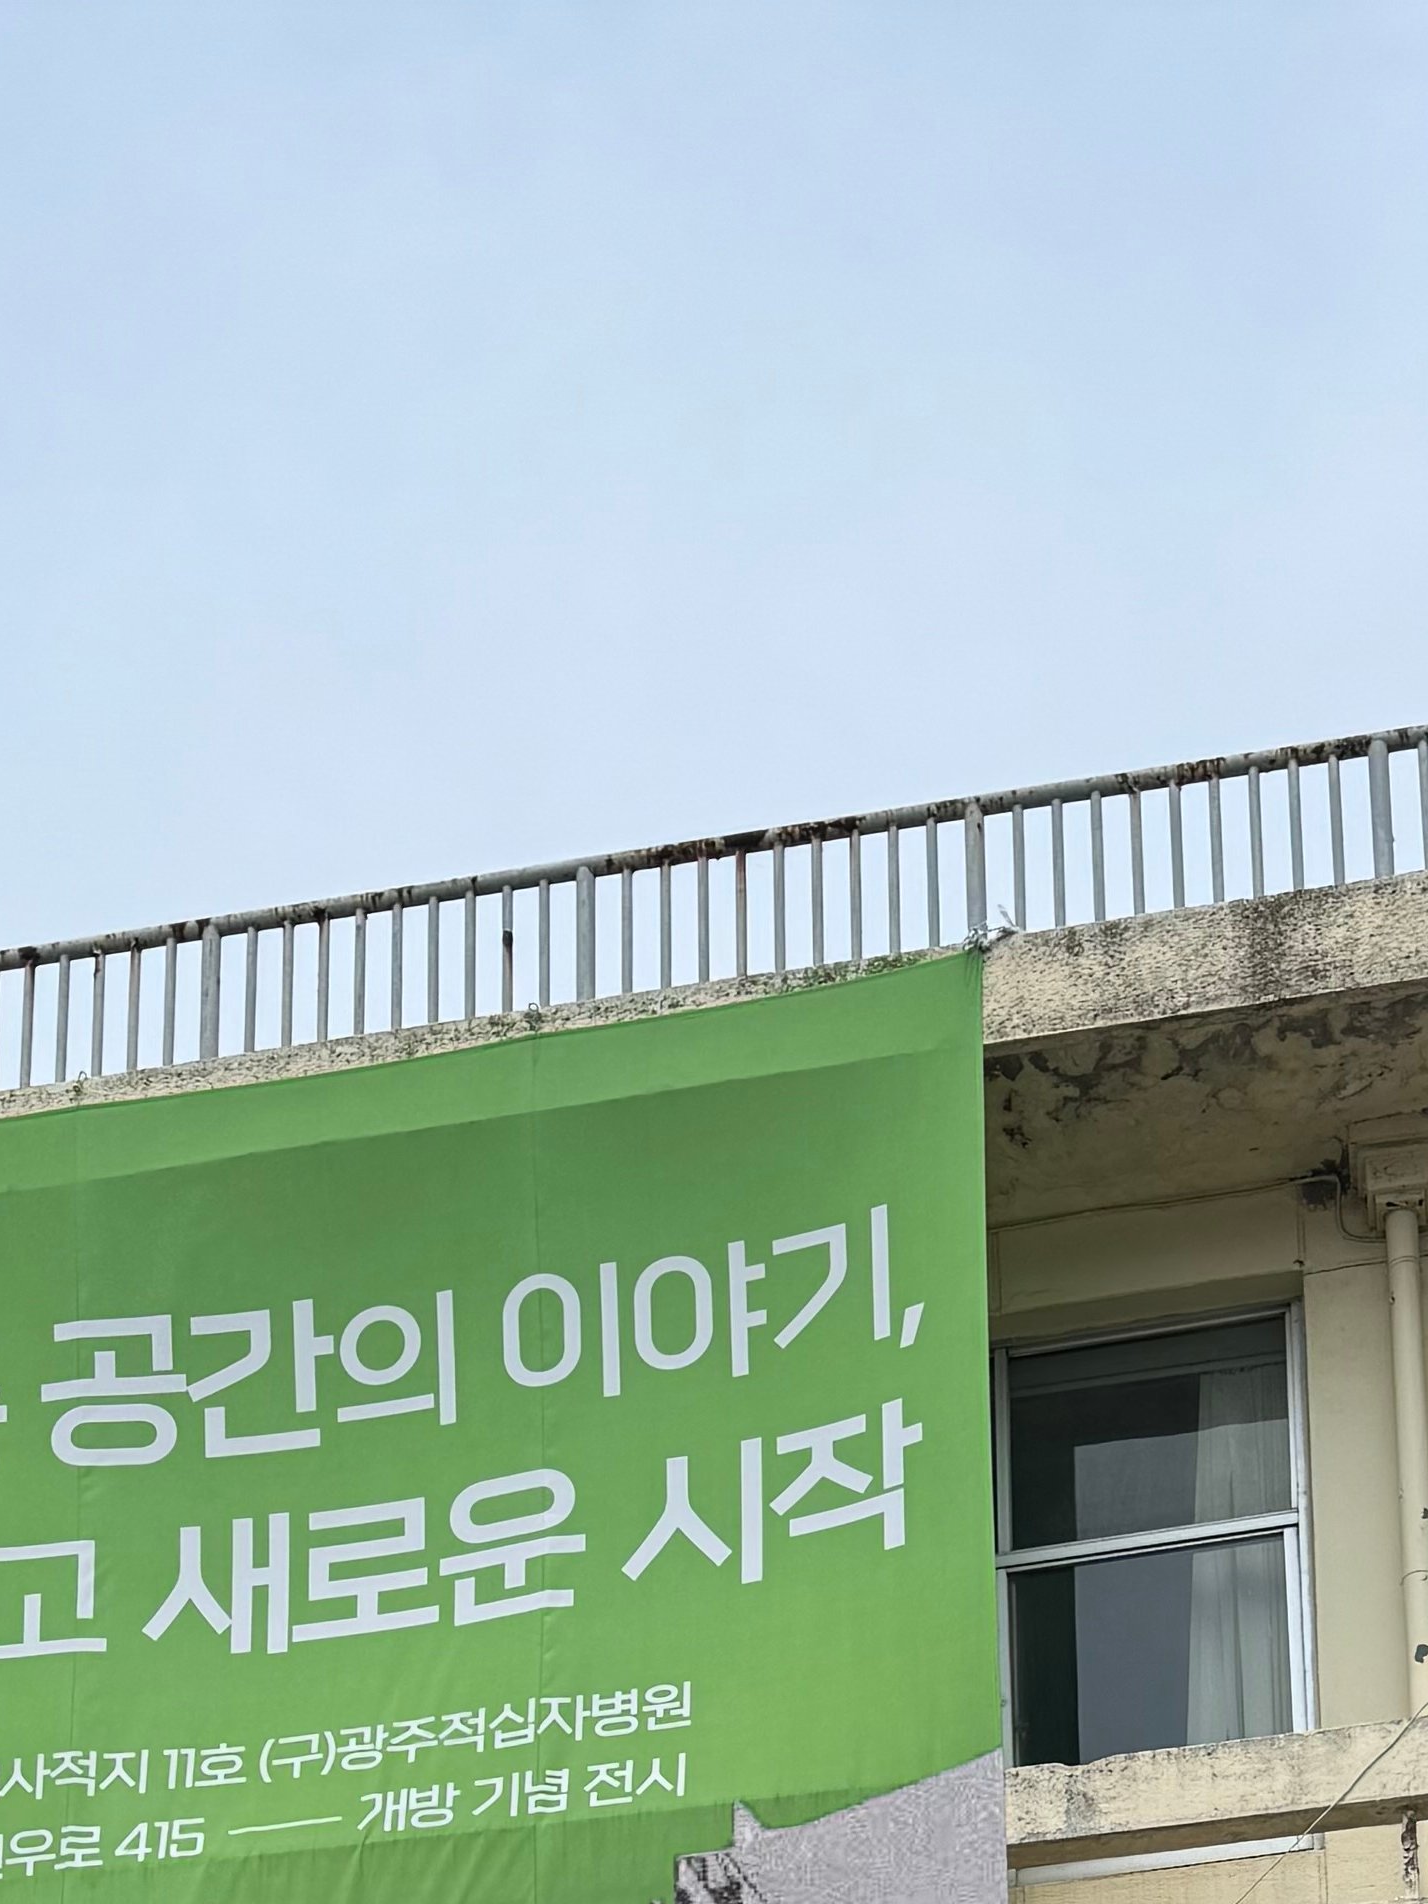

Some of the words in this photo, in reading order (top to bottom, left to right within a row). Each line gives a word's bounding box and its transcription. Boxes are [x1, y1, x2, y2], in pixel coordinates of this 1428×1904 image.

[40, 1288, 458, 1467] 공간의
[502, 1203, 925, 1398] 이야기,
[141, 1468, 587, 1655] 새로운
[621, 1397, 924, 1585] 시작
[114, 1817, 205, 1862] 415
[357, 1782, 461, 1832] 개방
[472, 1768, 570, 1818] 기념
[583, 1752, 686, 1808] 전시
[163, 1743, 246, 1790] 11호
[259, 1680, 692, 1787] (구)광주적십자병원
